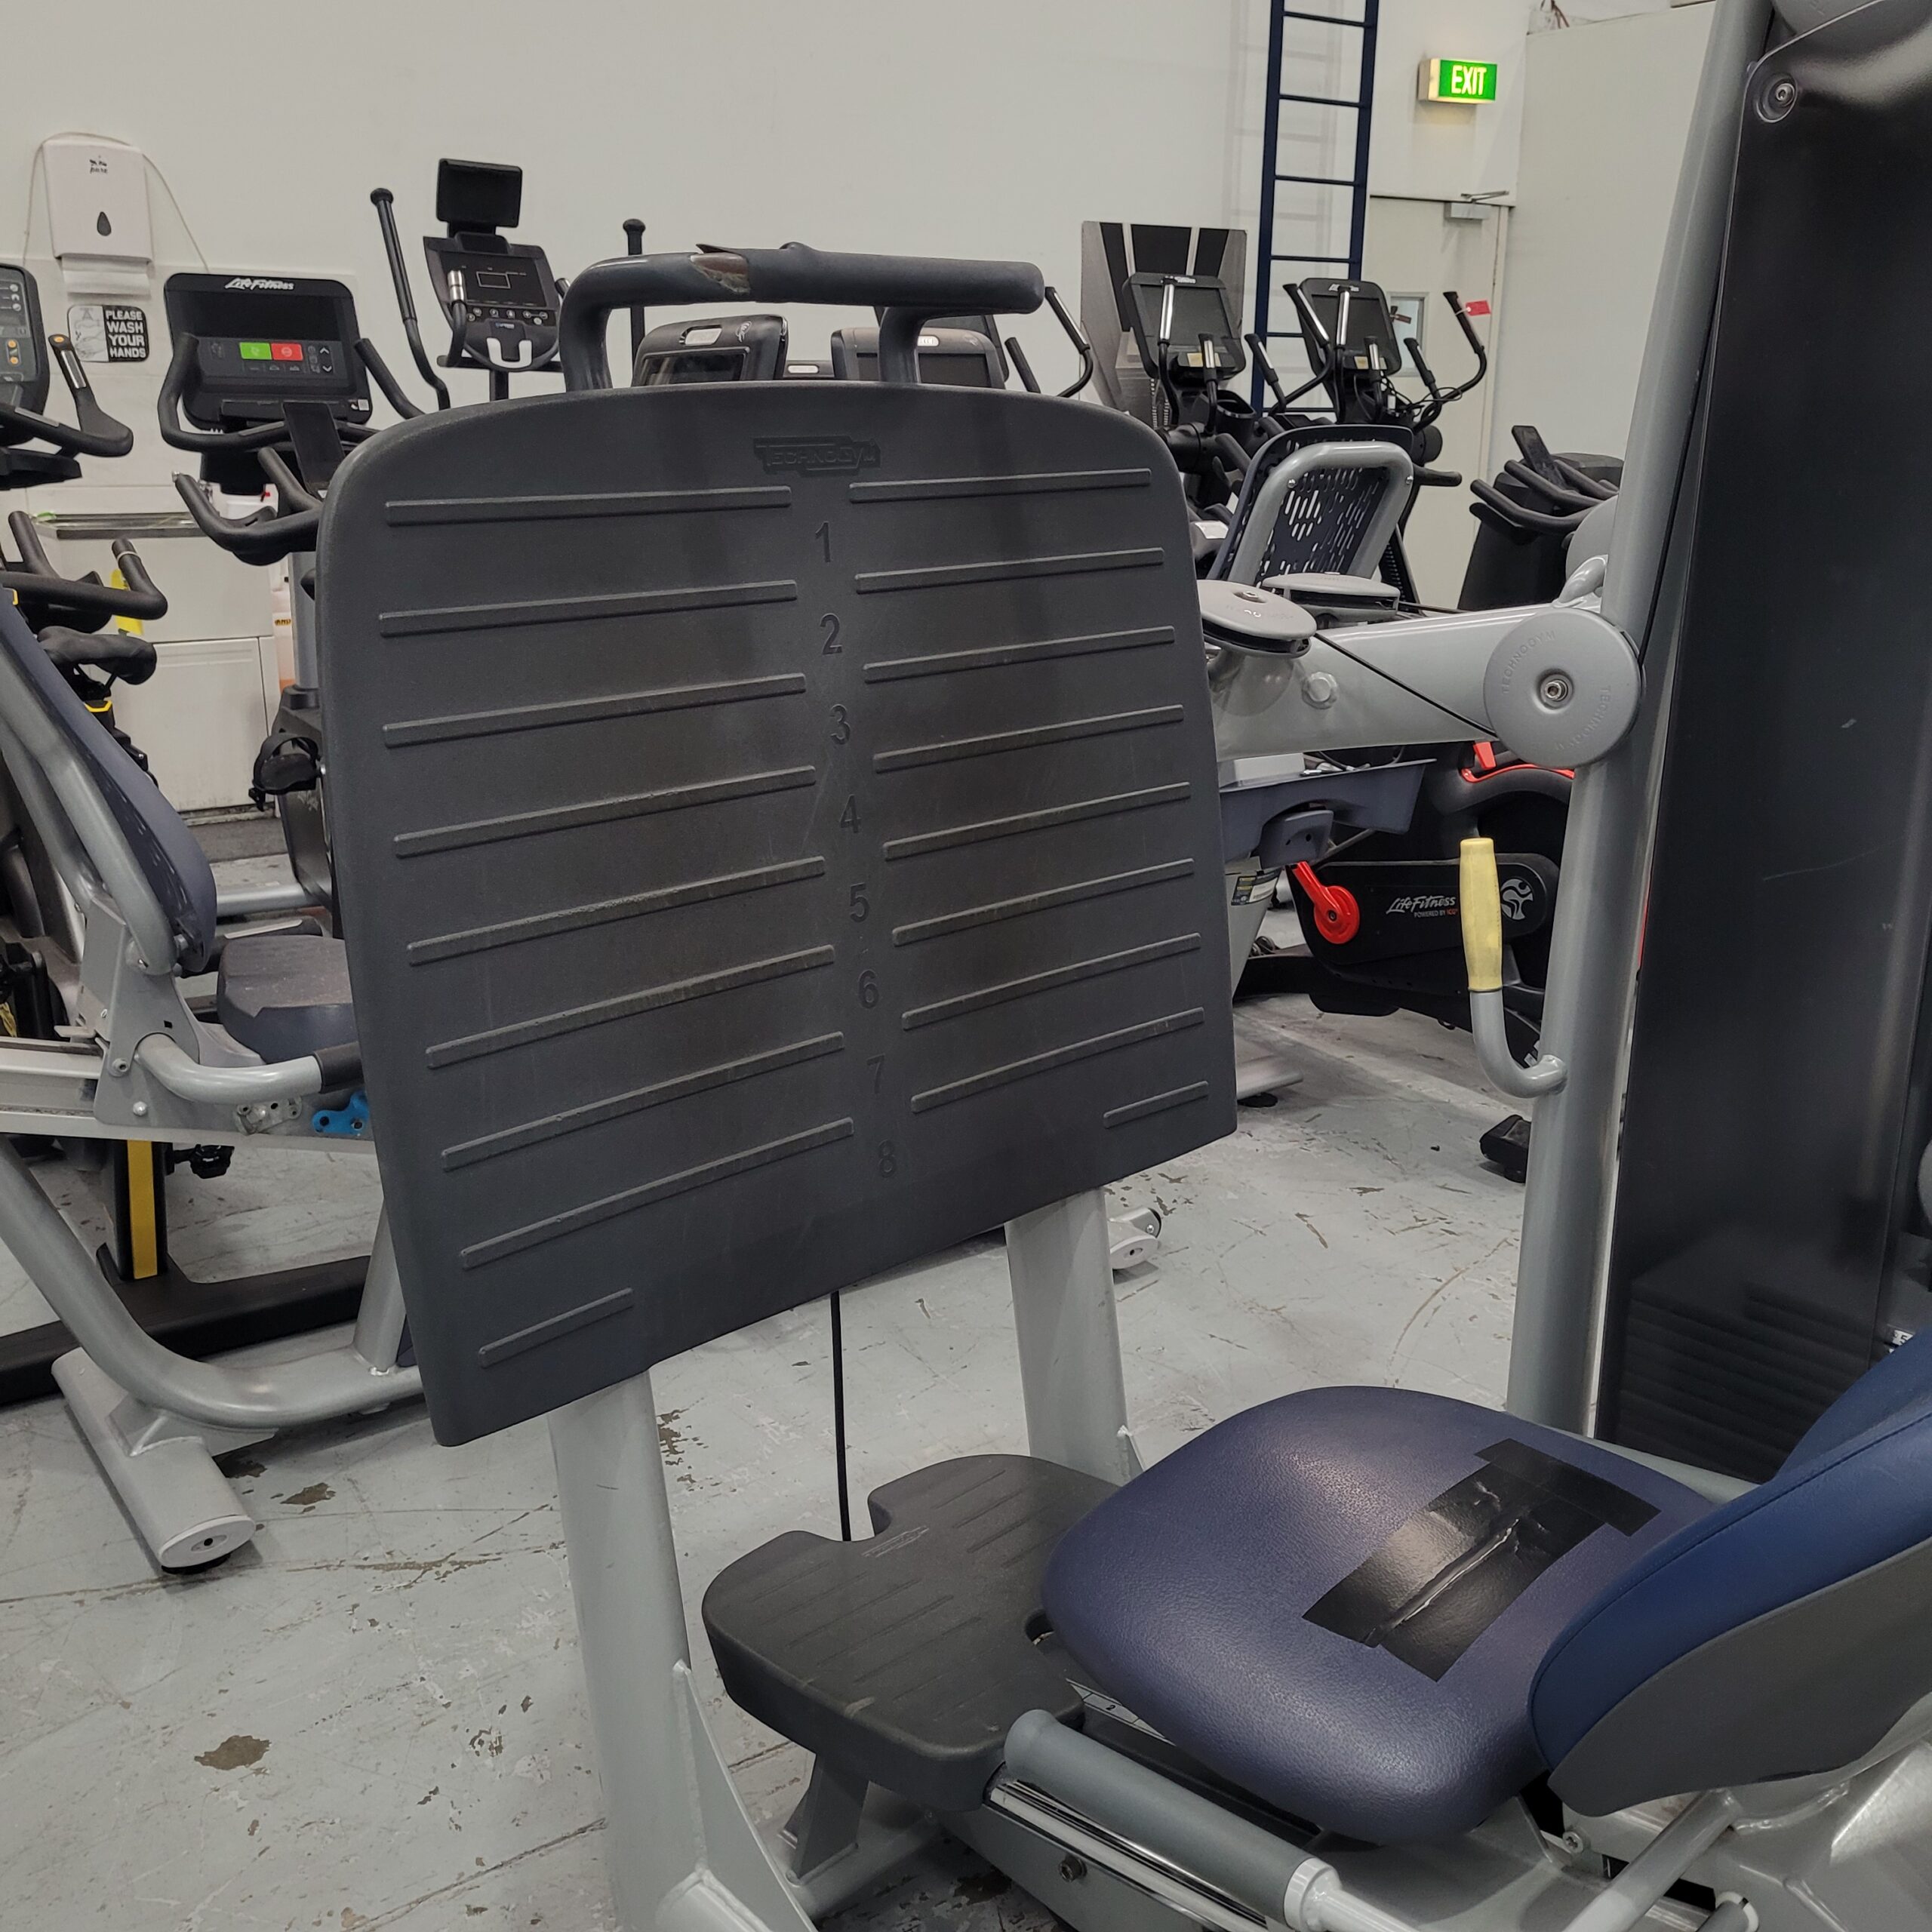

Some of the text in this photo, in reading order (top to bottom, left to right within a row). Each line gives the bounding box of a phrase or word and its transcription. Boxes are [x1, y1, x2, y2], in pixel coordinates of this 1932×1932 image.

[1451, 65, 1487, 96] EXIT
[106, 310, 143, 320] PLEASE
[106, 321, 143, 334] WASH
[109, 334, 145, 346] YOUR
[109, 347, 146, 358] HANDS
[815, 521, 831, 563] 1
[820, 613, 843, 655] 2
[830, 703, 851, 746] 3
[839, 793, 862, 834] 4
[850, 881, 869, 923] 5
[858, 969, 879, 1009] 6
[866, 1053, 886, 1094] 7
[878, 1140, 896, 1178] 8
